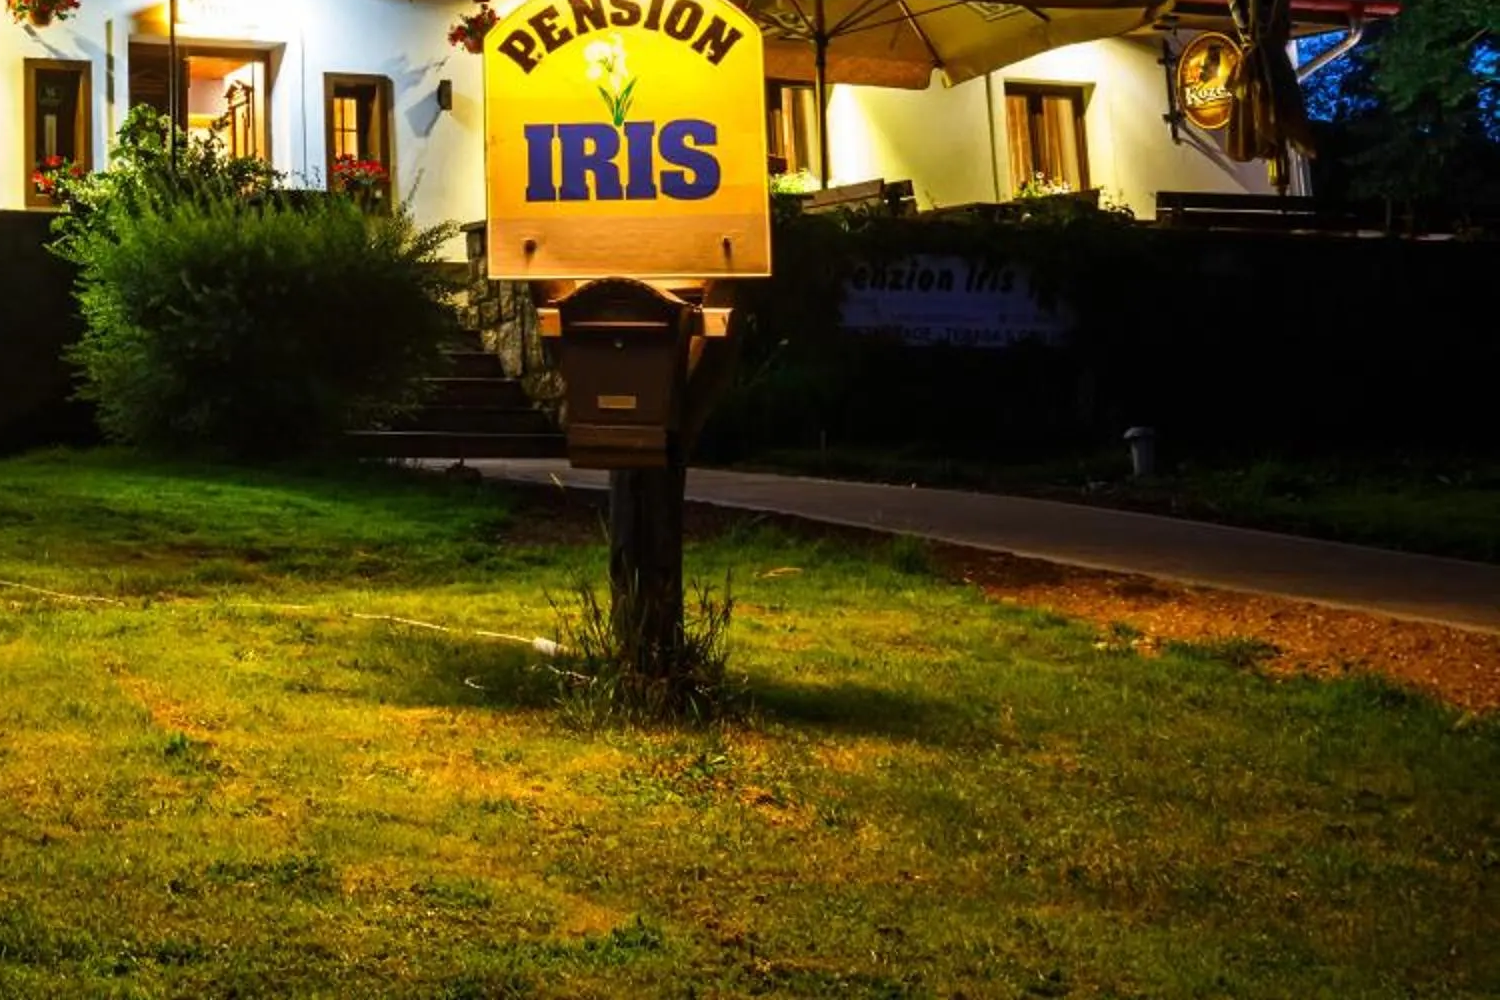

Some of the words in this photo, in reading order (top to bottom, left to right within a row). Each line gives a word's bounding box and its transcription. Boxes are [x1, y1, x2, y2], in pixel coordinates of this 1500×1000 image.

[1185, 87, 1233, 105] Koze
[524, 119, 721, 202] IRIS
[846, 260, 954, 292] enzion
